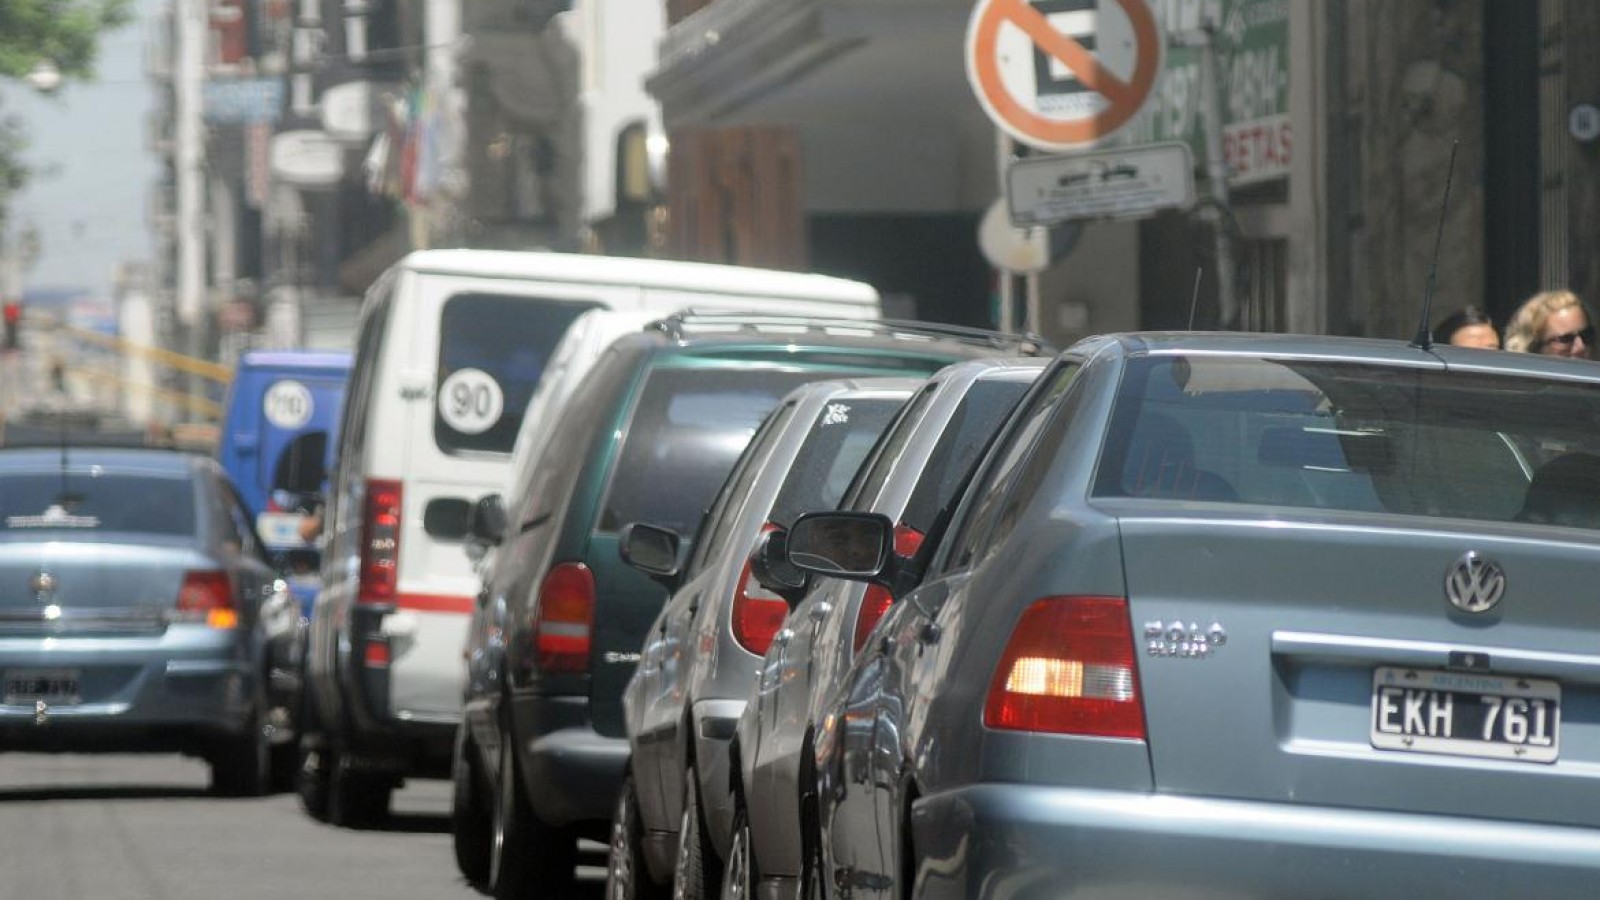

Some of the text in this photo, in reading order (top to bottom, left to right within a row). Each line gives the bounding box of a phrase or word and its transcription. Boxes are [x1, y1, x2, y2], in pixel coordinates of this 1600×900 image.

[453, 382, 492, 418] 90
[1379, 687, 1552, 746] EKH 761
